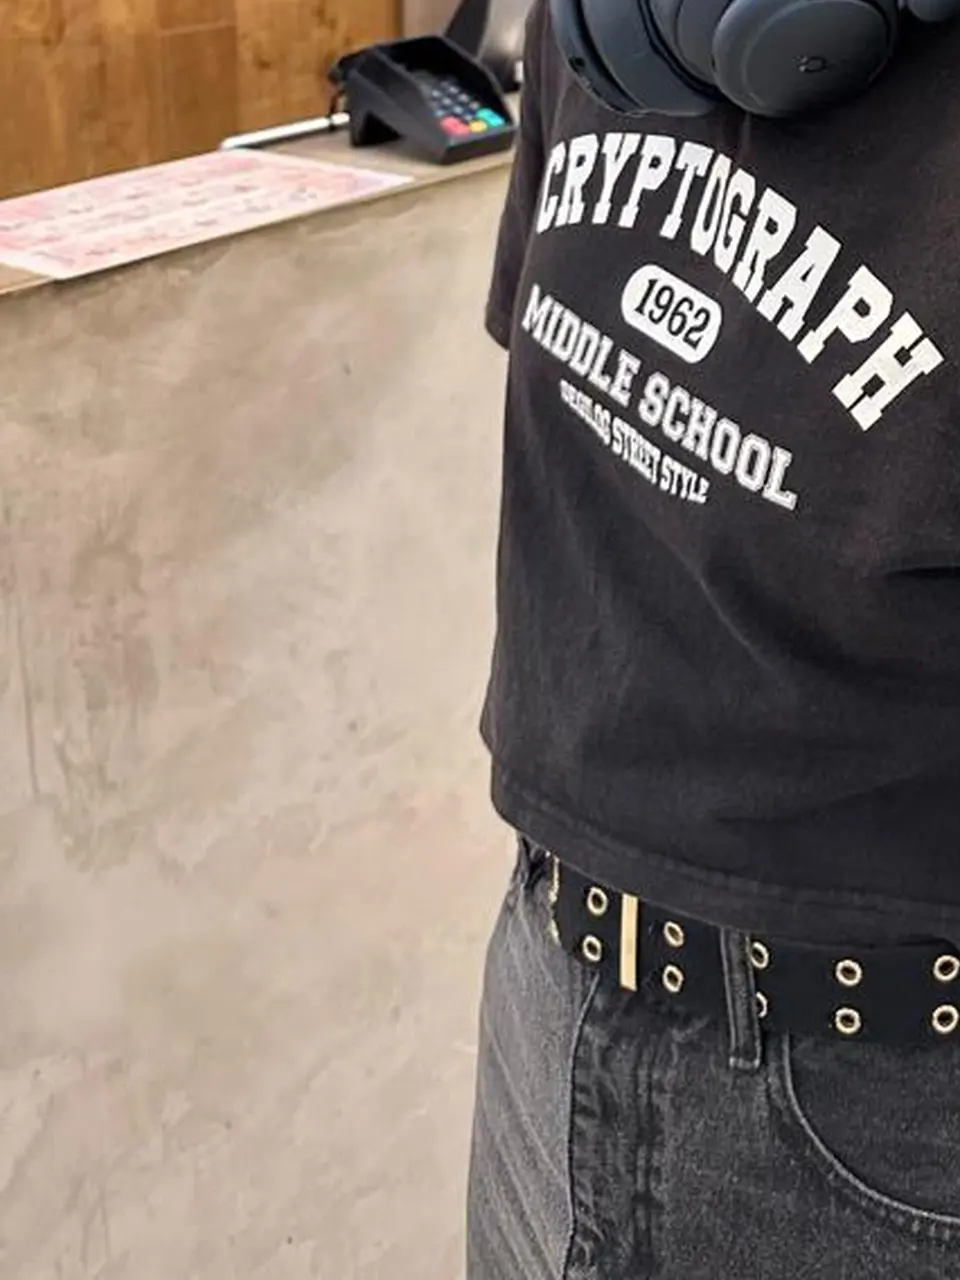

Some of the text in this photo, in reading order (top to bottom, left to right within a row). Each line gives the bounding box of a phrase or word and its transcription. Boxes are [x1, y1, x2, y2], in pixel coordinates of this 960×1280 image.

[536, 132, 945, 432] CRYPTOGRAPH
[634, 277, 713, 352] 1962
[521, 284, 642, 408] MIDDLE
[638, 371, 798, 511] SCHOOL
[659, 454, 710, 504] STYLE
